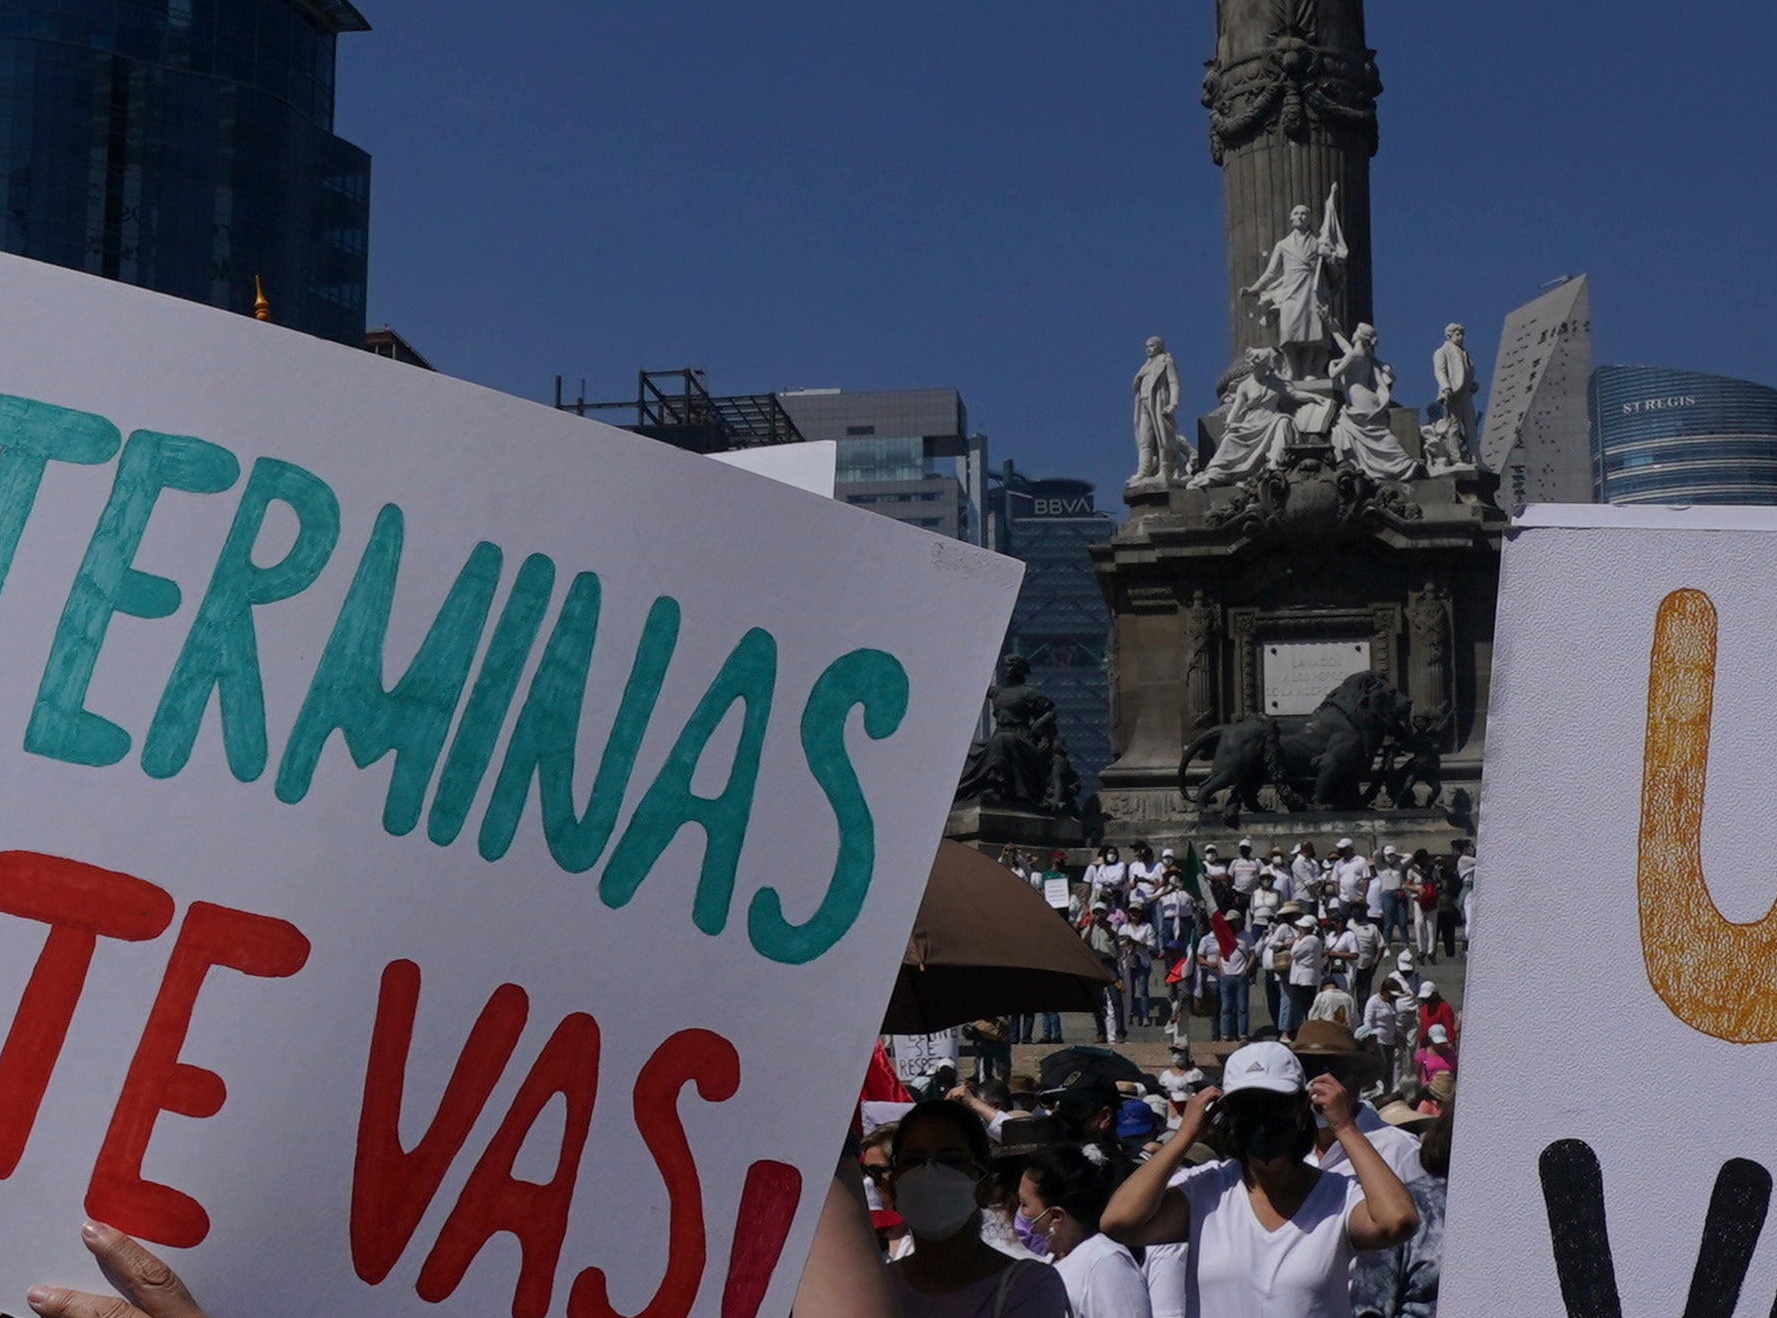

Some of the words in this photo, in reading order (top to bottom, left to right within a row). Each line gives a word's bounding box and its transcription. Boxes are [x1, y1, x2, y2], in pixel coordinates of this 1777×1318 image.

[1645, 395, 1696, 410] REGIS
[1034, 498, 1091, 515] BBVA
[900, 1057, 943, 1077] RESPE
